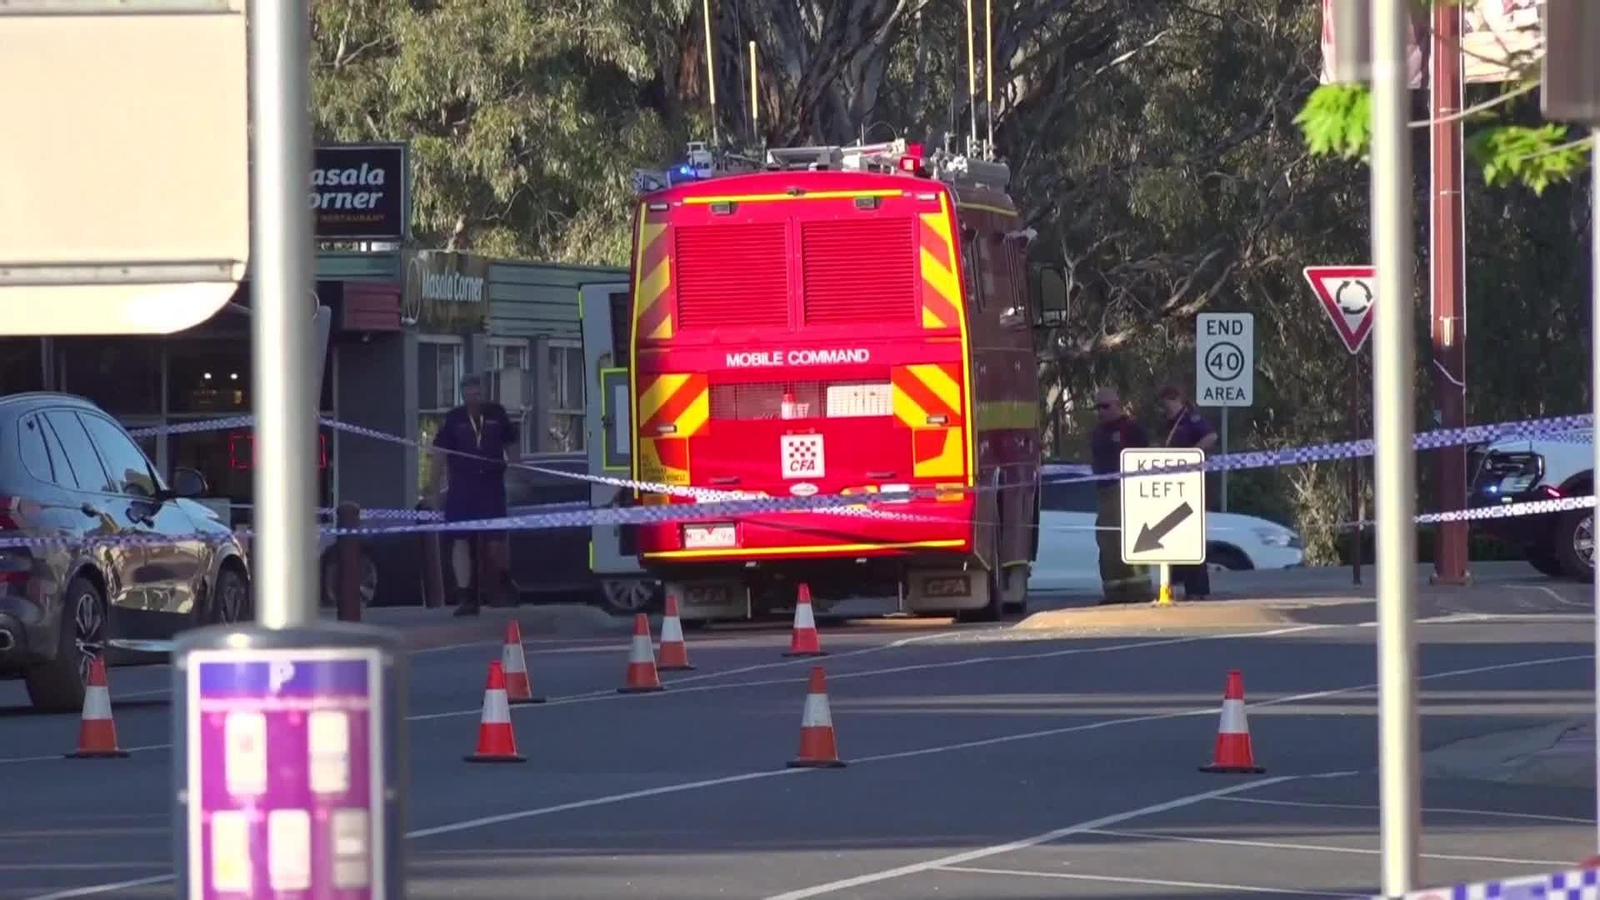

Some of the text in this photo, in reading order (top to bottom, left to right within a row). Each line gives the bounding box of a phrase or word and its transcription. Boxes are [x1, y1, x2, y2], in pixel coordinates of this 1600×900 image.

[310, 162, 386, 186] asala
[308, 191, 384, 209] orner
[422, 267, 484, 302] Masala Corner
[1207, 320, 1243, 336] END
[726, 349, 870, 367] MOBILE COMMAND
[1210, 353, 1240, 371] 40
[1204, 387, 1246, 400] AREA
[790, 460, 815, 472] CFA
[1139, 482, 1186, 498] LEFT
[927, 580, 967, 594] CFA
